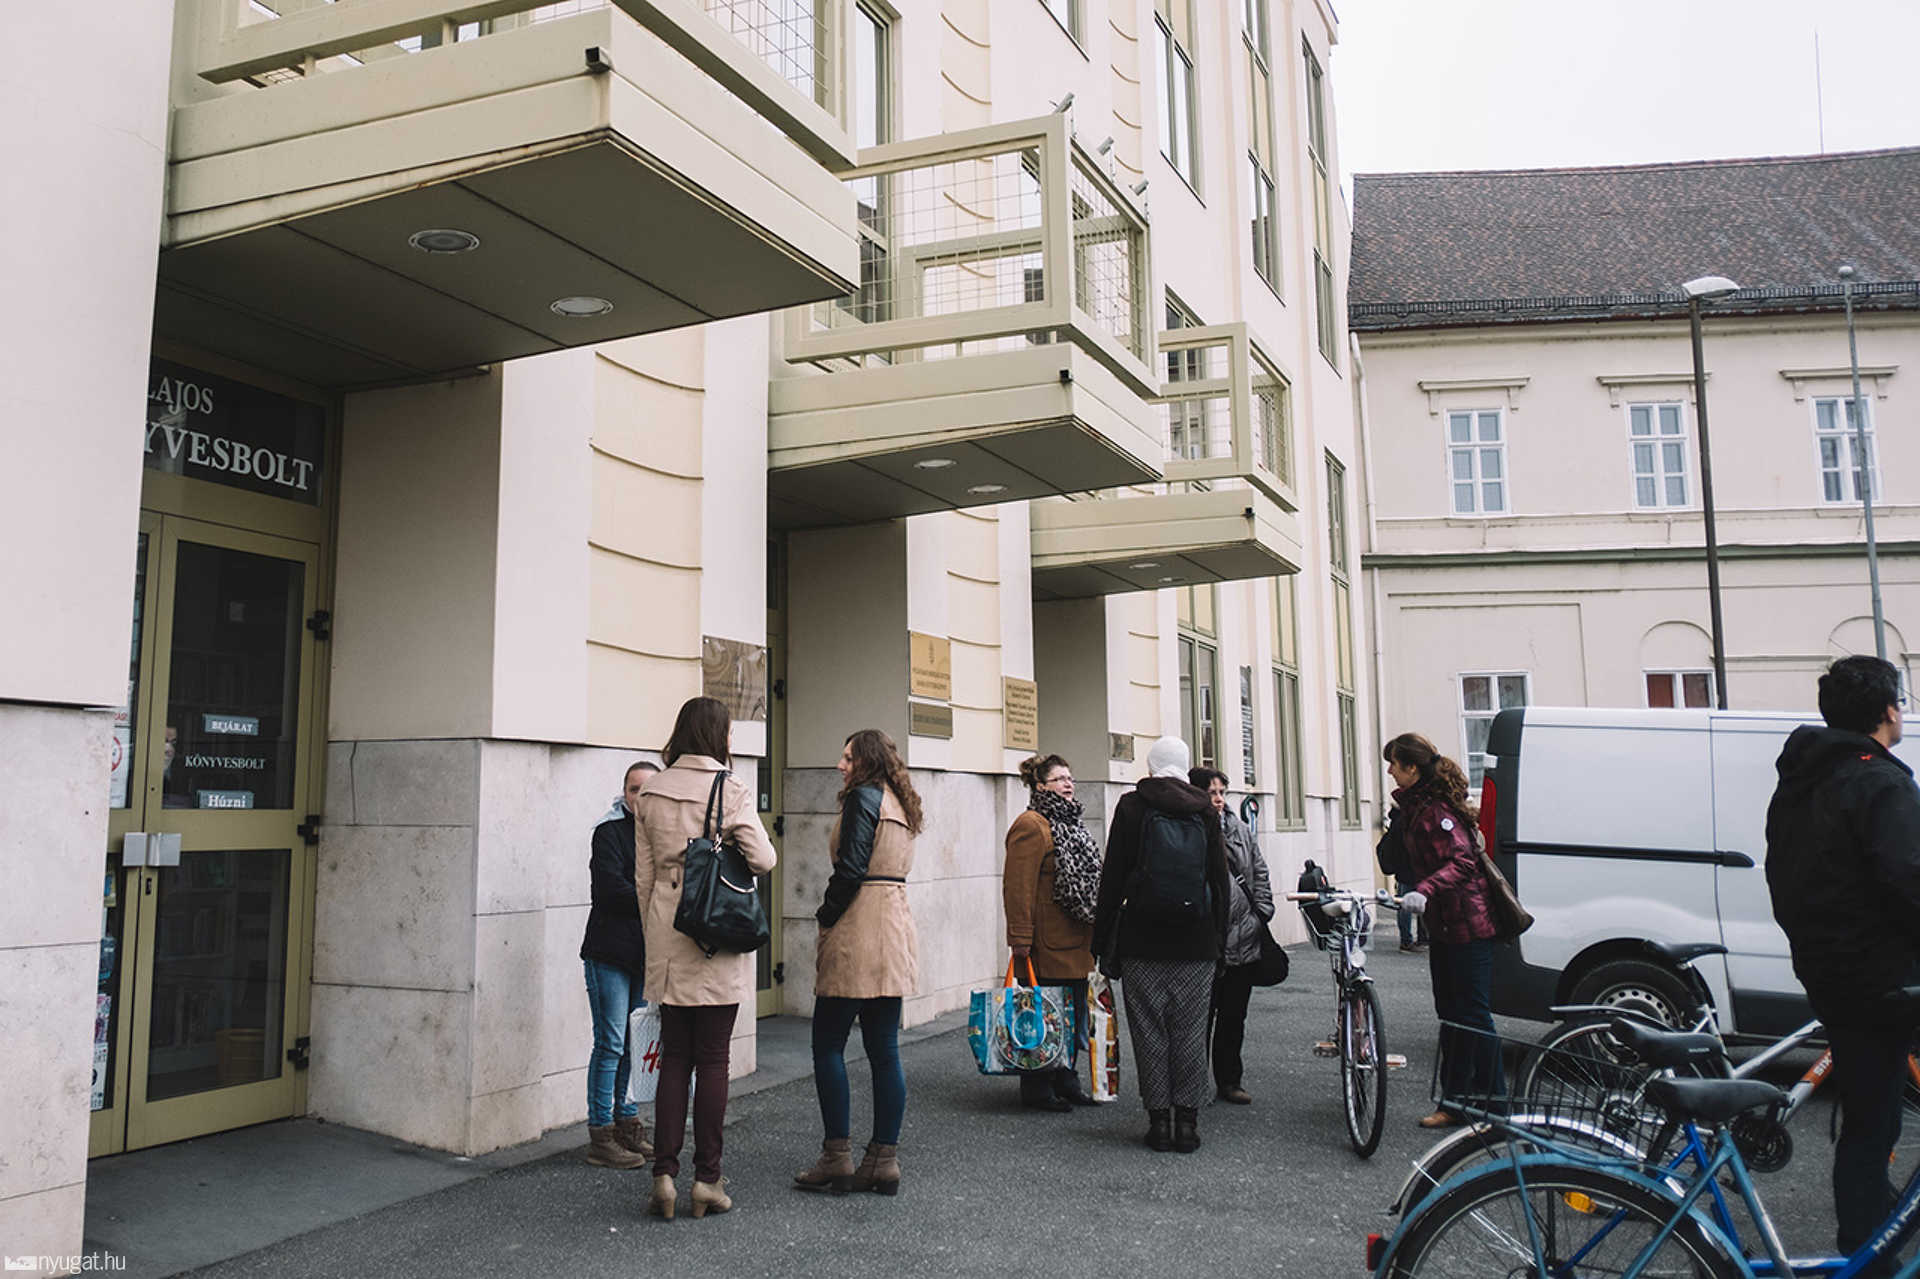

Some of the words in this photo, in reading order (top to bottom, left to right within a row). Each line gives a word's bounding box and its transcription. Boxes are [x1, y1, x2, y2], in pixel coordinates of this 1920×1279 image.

[144, 422, 313, 490] YVESBOLT
[211, 720, 253, 733] BEJÁRAT
[208, 794, 246, 808] Húzni
